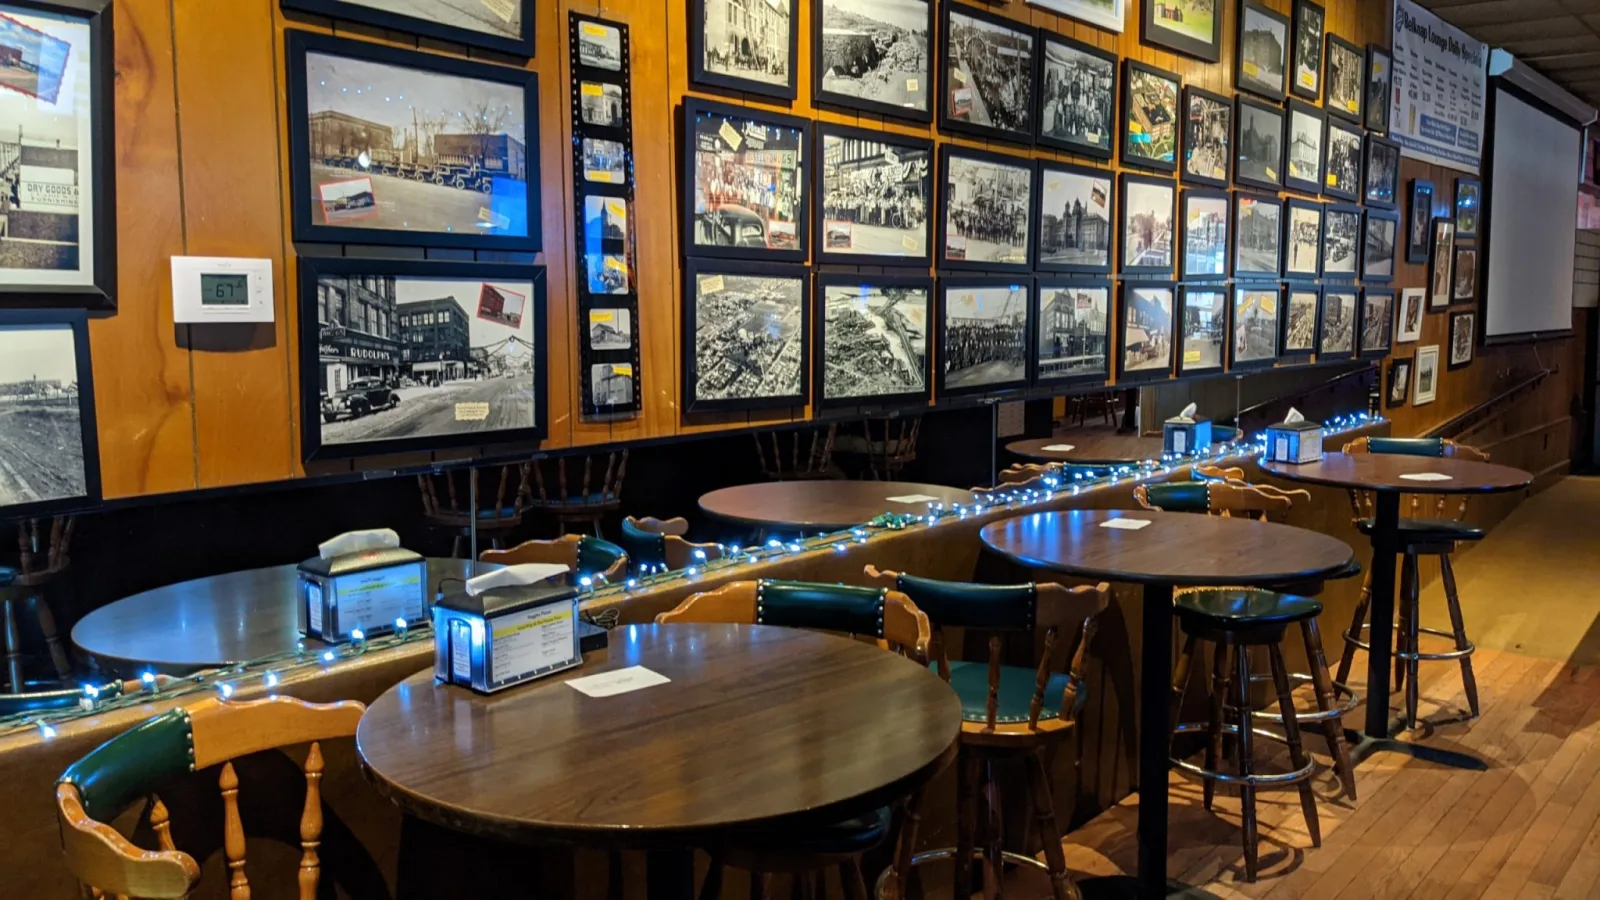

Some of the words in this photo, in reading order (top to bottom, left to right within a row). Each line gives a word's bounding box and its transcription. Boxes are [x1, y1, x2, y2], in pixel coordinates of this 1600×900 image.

[1404, 11, 1427, 44] Belknap
[1428, 24, 1447, 52] Lounge
[27, 183, 43, 193] DRY
[46, 185, 71, 195] GOODS
[216, 283, 234, 298] 67
